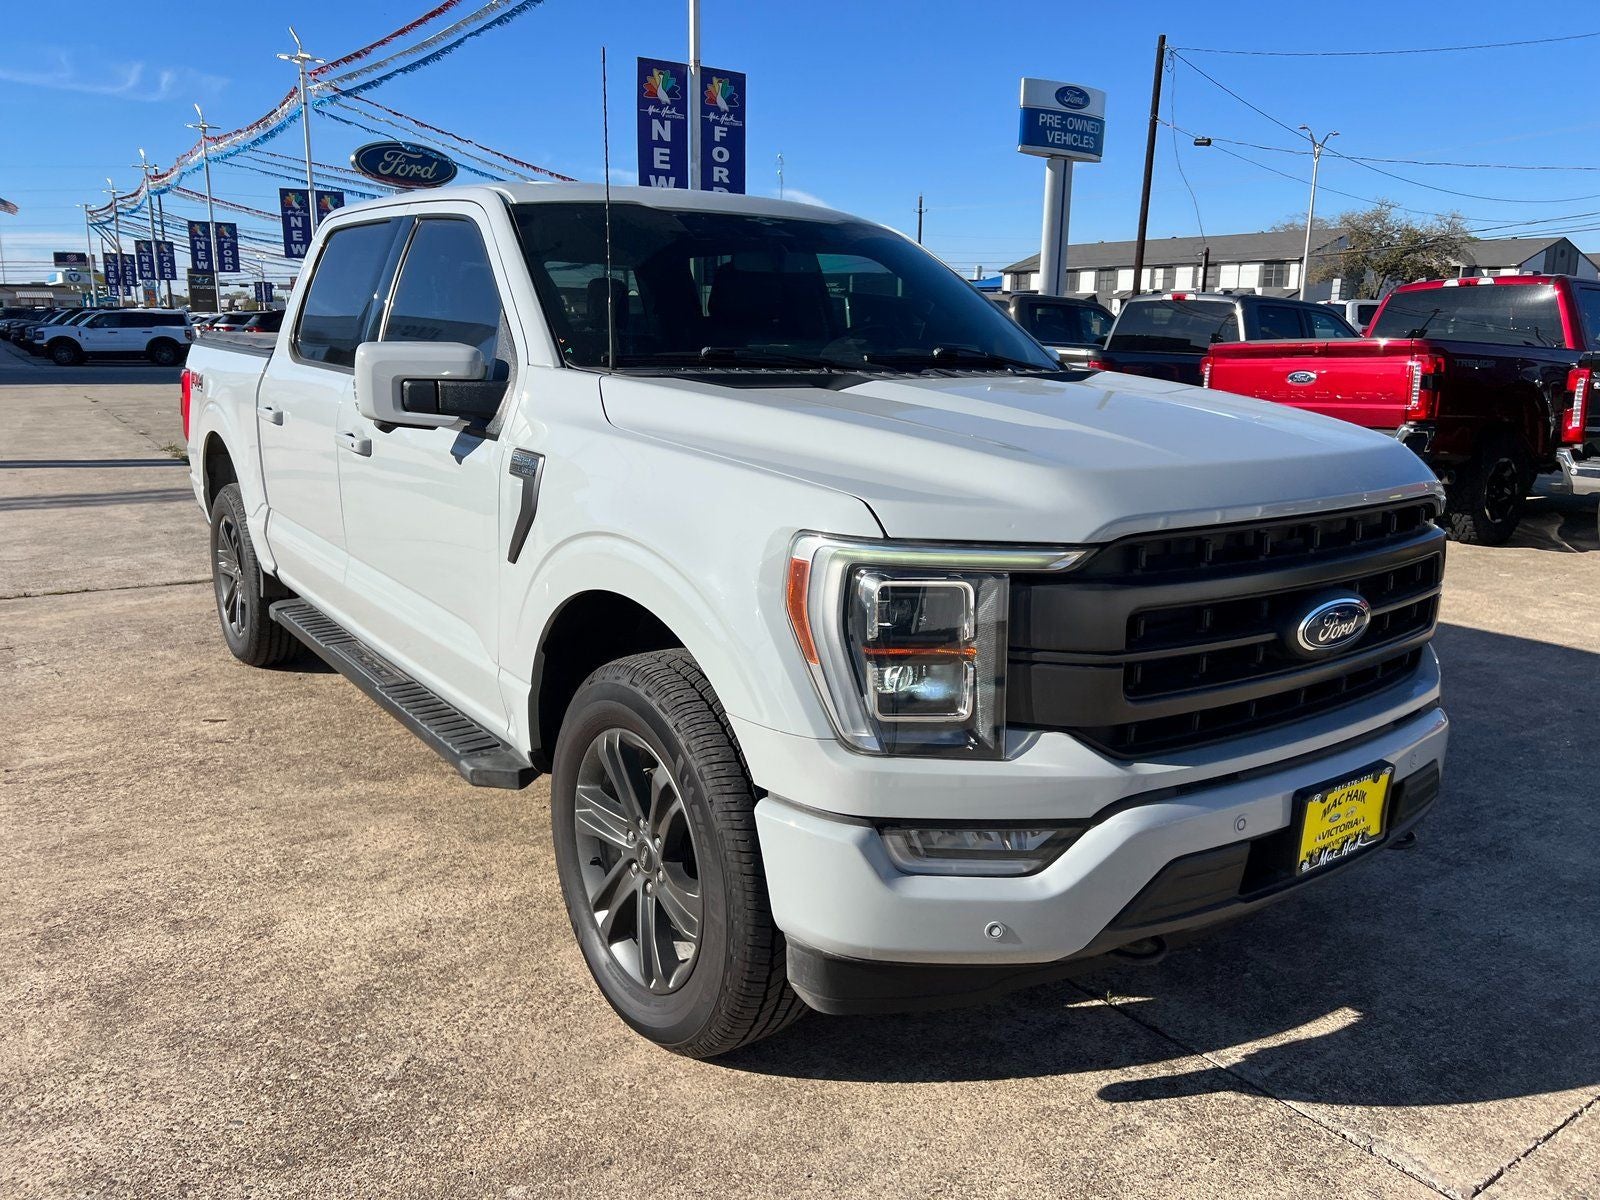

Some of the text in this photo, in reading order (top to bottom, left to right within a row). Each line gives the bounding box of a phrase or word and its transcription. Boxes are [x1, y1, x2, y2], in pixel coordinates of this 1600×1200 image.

[1064, 89, 1085, 105] Ford
[1038, 113, 1100, 134] PRE-OWNED
[1046, 130, 1095, 149] VEHICLES
[378, 150, 437, 179] Ford
[649, 119, 676, 189] NEW
[290, 216, 307, 255] NEW
[141, 255, 152, 278] NEW
[196, 241, 209, 270] NEW
[223, 242, 234, 271] FORD
[107, 266, 117, 284] NEW
[125, 266, 133, 285] FORD
[163, 257, 172, 279] FORD
[1455, 359, 1497, 369] TREMOR
[1318, 613, 1358, 642] Ford
[1321, 794, 1346, 820] MAC
[1345, 788, 1368, 804] HAIK
[1321, 818, 1360, 840] VICTORIA
[1341, 834, 1368, 856] Haik
